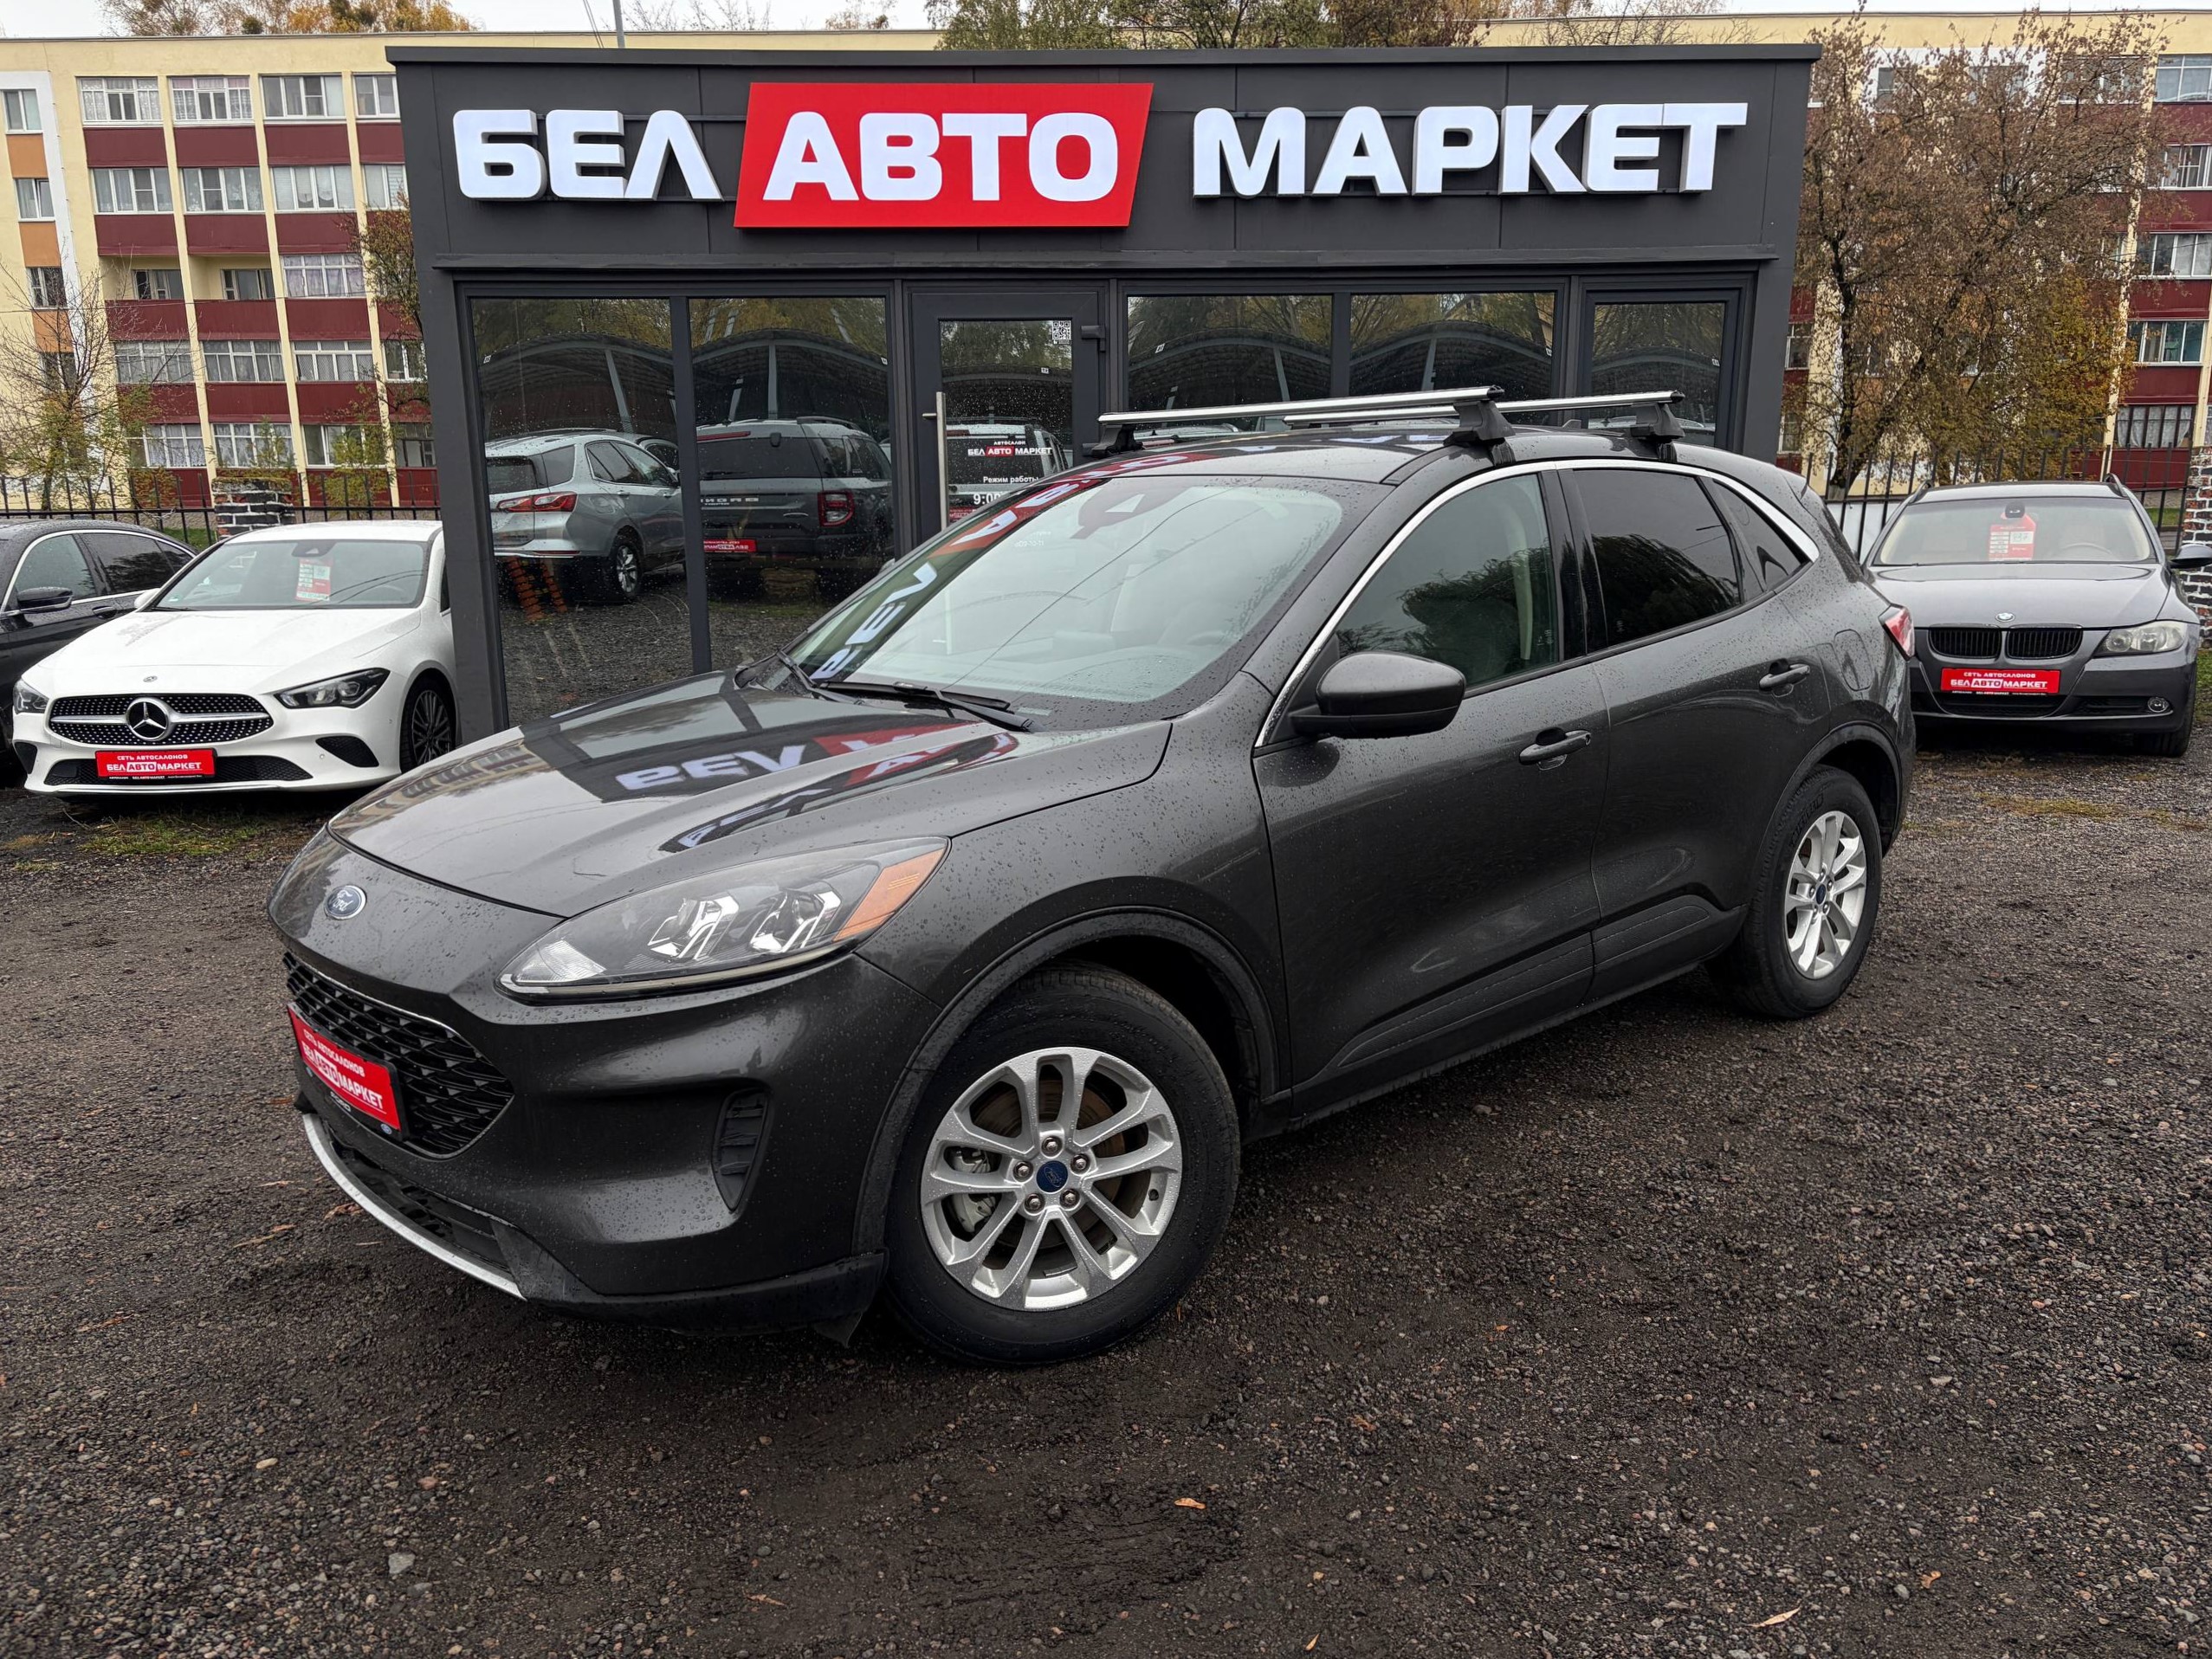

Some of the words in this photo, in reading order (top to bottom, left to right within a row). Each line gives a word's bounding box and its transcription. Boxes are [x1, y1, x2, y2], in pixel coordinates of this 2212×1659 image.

[453, 109, 722, 201] БЕЛ
[762, 111, 1118, 203] АВТО
[1192, 102, 1749, 199] МАРКЕТ
[1015, 447, 1052, 455] МАРКЕТ
[983, 475, 1009, 484] Режим
[157, 762, 202, 771] МАРКЕТ
[331, 889, 354, 912] Ford
[317, 1040, 365, 1078] АВТОСАЛОНОВ
[339, 1072, 383, 1110] МАРКЕТ
